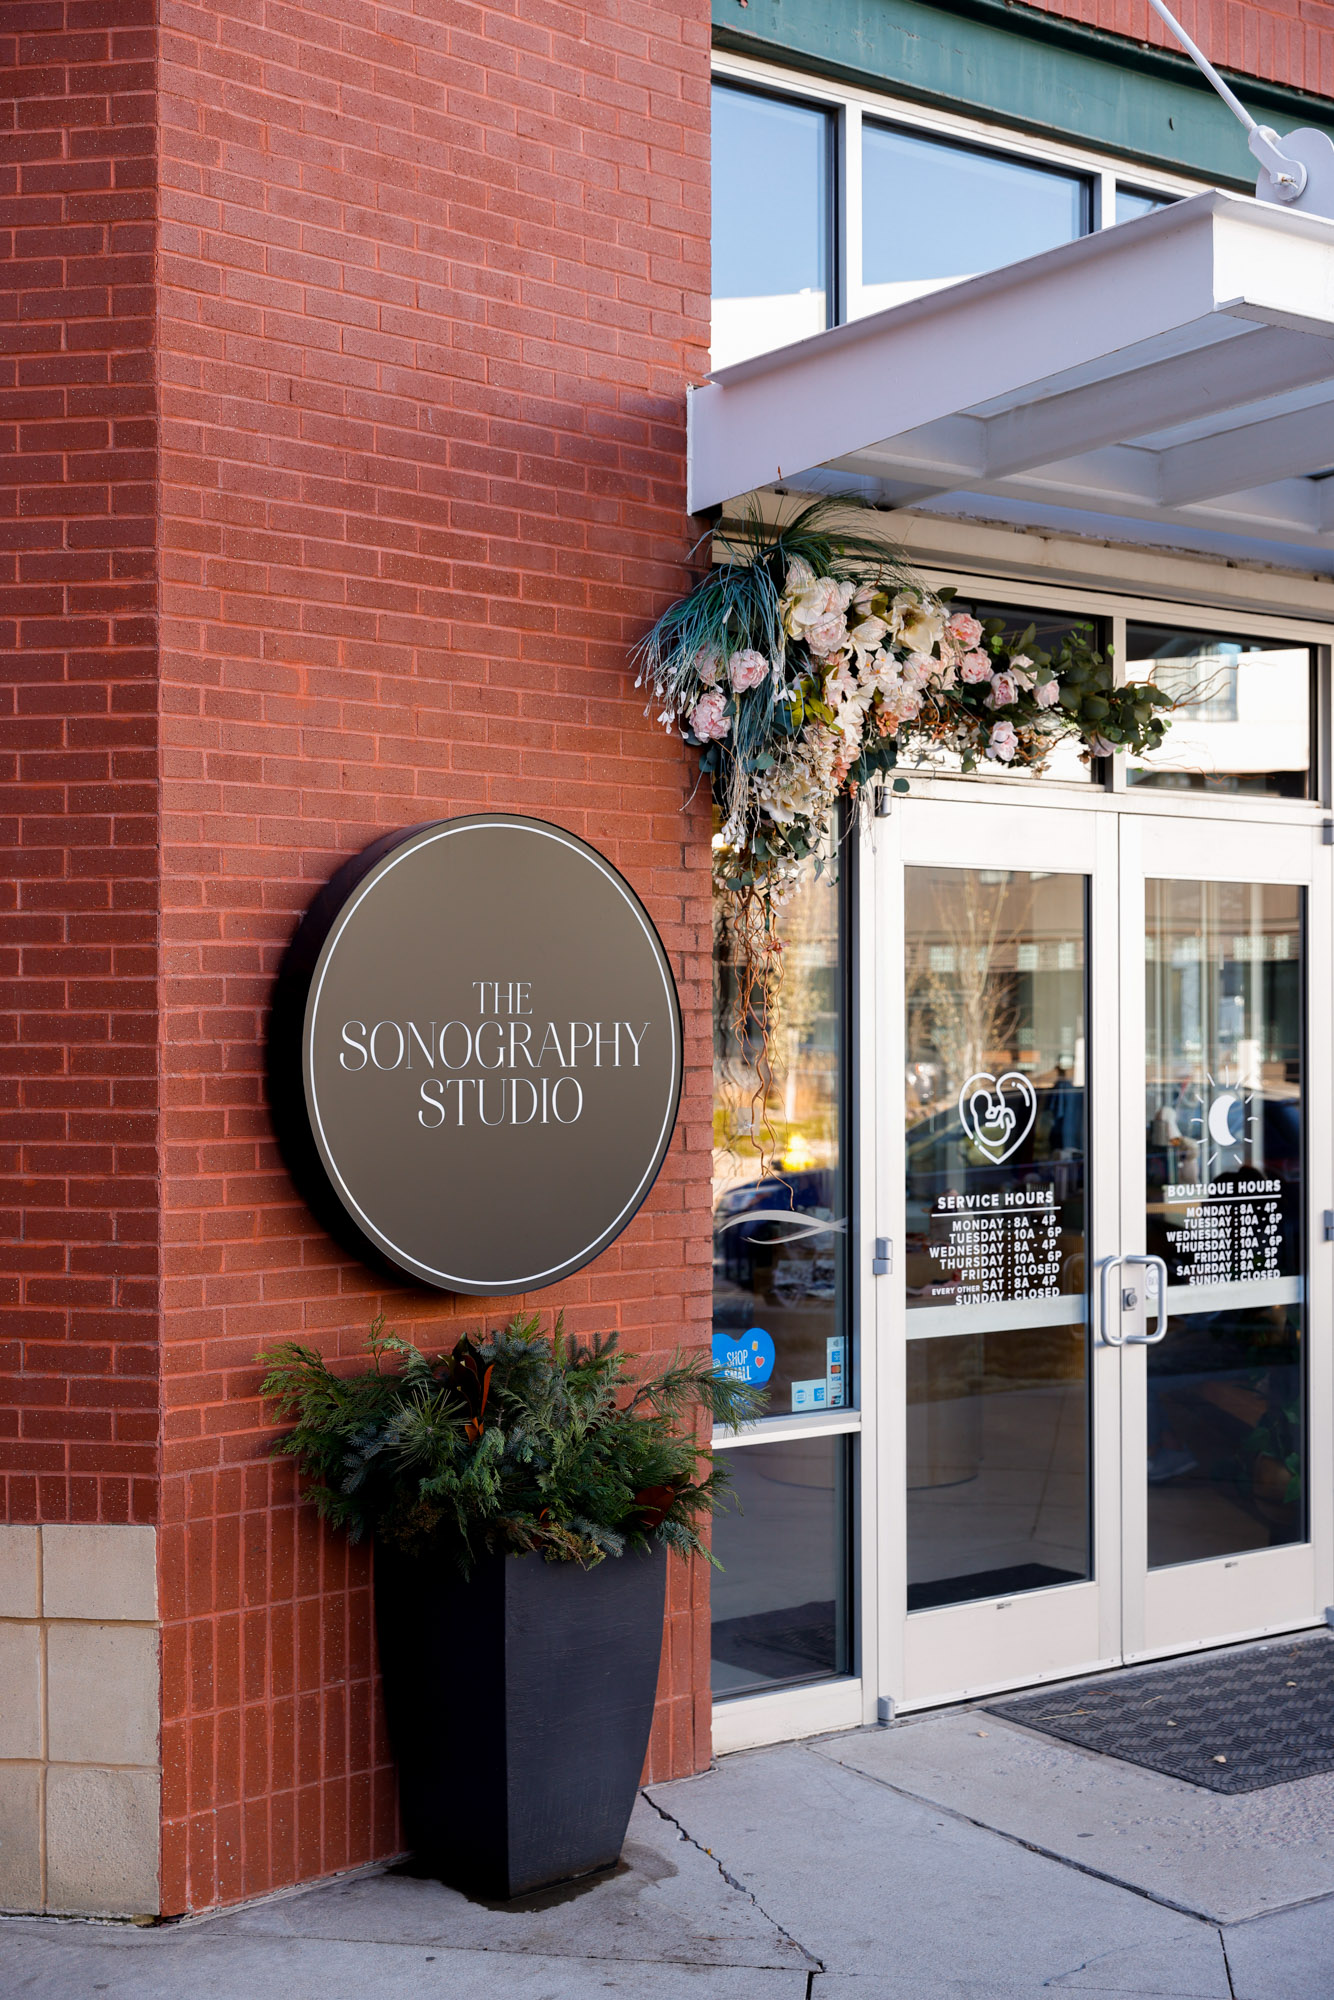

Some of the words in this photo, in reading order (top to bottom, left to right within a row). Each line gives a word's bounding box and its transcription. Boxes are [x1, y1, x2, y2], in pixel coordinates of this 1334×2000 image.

[472, 981, 533, 1015] THE
[339, 1020, 651, 1071] SONOGRAPHY
[418, 1076, 584, 1129] STUDIO
[1167, 1183, 1234, 1197] BOUTIQUE
[1238, 1180, 1281, 1194] HOURS
[938, 1194, 999, 1210] SERVICE
[1005, 1191, 1054, 1206] HOURS
[1186, 1205, 1232, 1217] MONDAY
[1240, 1204, 1254, 1214] 8A
[1264, 1203, 1277, 1212] 4P
[952, 1218, 1005, 1232] MONDAY
[1014, 1217, 1029, 1228] 8A
[1042, 1215, 1057, 1226] 4P
[1184, 1217, 1232, 1229] TUESDAY
[1240, 1215, 1259, 1225] 10A
[1269, 1214, 1282, 1224] 6P
[949, 1231, 1005, 1244] TUESDAY
[1014, 1229, 1035, 1240] 10A
[1048, 1227, 1062, 1238] 6P
[1166, 1228, 1232, 1242] WEDNESDAY
[1240, 1227, 1254, 1237] 8A
[1264, 1225, 1277, 1235] 4P
[929, 1243, 1005, 1258] WEDNESDAY
[1014, 1241, 1030, 1252] 8A
[1042, 1239, 1057, 1250] 4P
[1175, 1239, 1232, 1253] THURSDAY
[1240, 1238, 1259, 1248] 10A
[1269, 1236, 1282, 1246] 6P
[940, 1255, 1005, 1270] THURSDAY
[1014, 1253, 1035, 1264] 10A
[1048, 1251, 1062, 1262] 6P
[1194, 1251, 1232, 1263] FRIDAY
[1240, 1249, 1254, 1259] 9A
[1264, 1248, 1278, 1258] 5P
[961, 1267, 1005, 1281] FRIDAY
[1014, 1263, 1060, 1276] CLOSED
[1176, 1262, 1232, 1276] SATURDAY
[1240, 1261, 1254, 1271] 8A
[1264, 1259, 1278, 1269] 4P
[932, 1287, 955, 1296] EVERY
[957, 1285, 980, 1293] OTHER
[982, 1280, 1005, 1291] SAT
[1014, 1278, 1030, 1288] 8A
[1042, 1276, 1057, 1287] 4P
[1189, 1273, 1232, 1286] SUNDAY
[1240, 1270, 1280, 1282] CLOSED
[955, 1292, 1005, 1305] SUNDAY
[1014, 1287, 1060, 1300] CLOSED
[726, 1350, 748, 1367] SHOP
